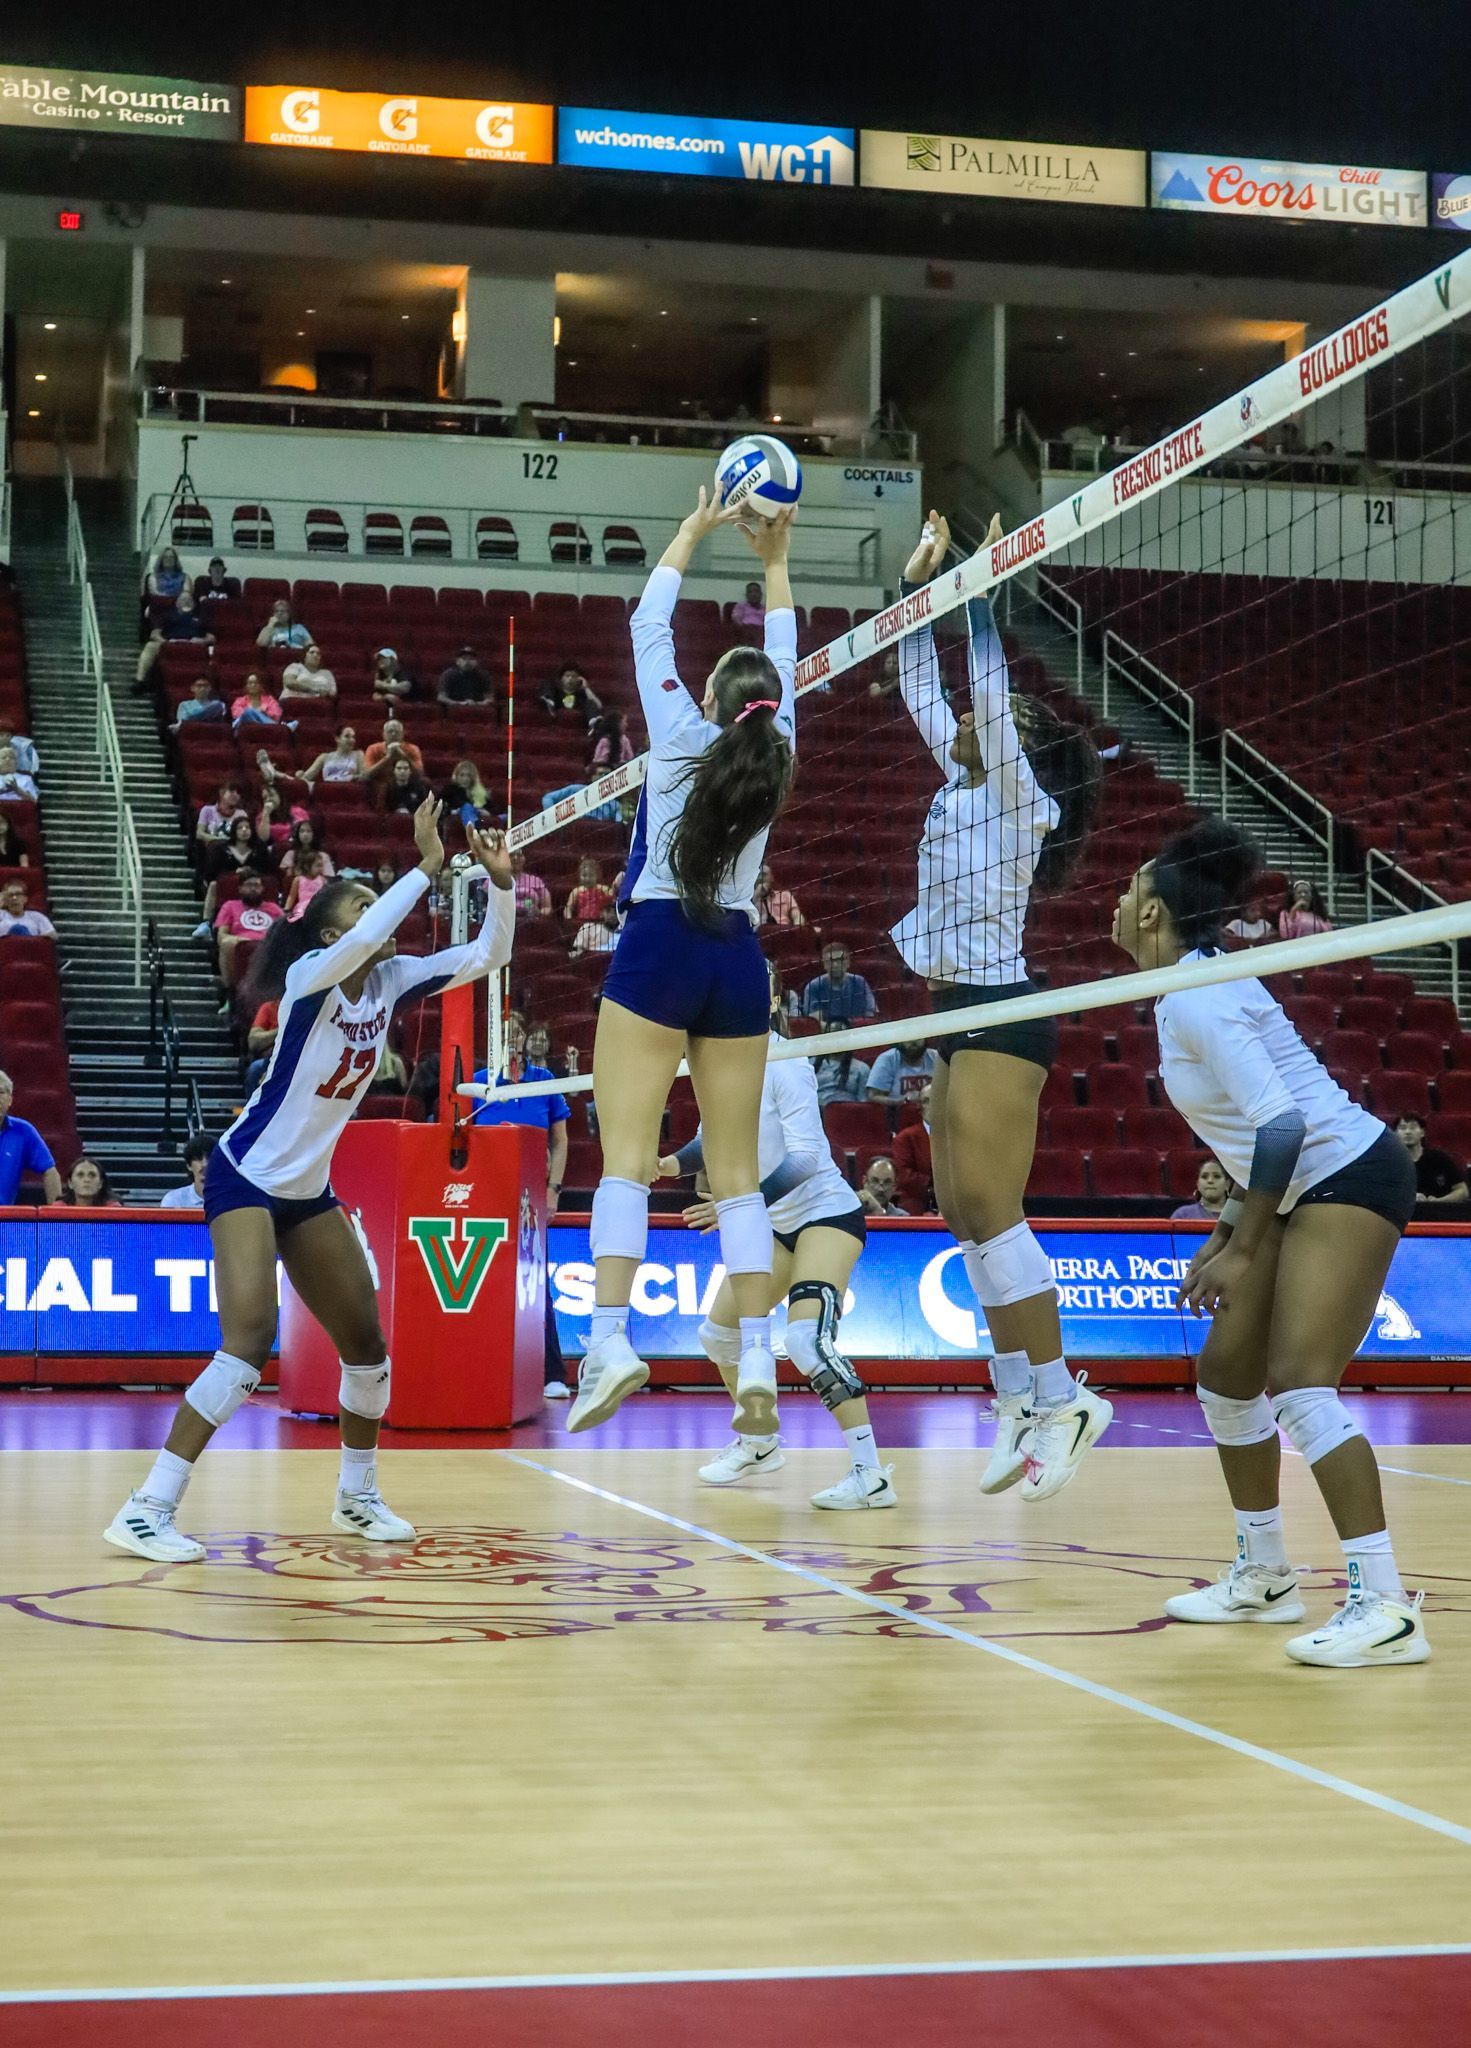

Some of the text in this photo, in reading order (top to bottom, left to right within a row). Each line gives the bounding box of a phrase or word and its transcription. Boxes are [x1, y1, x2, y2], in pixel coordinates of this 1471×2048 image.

[0, 78, 231, 114] able Mountain
[33, 102, 185, 126] Casino Resort
[270, 132, 333, 146] GATORADE
[368, 140, 431, 154] GATORADE
[575, 126, 725, 154] wchomes.com
[465, 147, 527, 162] GATORADE
[950, 143, 1100, 181] PALMILLA
[1338, 168, 1381, 185] Chill
[1207, 165, 1420, 218] Coors LIGHT
[1439, 198, 1468, 216] BLUE
[1299, 308, 1388, 397] BULLDOGS
[522, 452, 558, 480] 122
[844, 468, 914, 483] COCKTAILS
[1113, 422, 1205, 505] FRESNO STATE
[1364, 499, 1393, 525] 121
[991, 518, 1046, 577] BULLDOGS
[874, 587, 932, 644] FRESNO STATE
[408, 1216, 508, 1313] V
[1050, 1255, 1192, 1280] IERRA PACIF
[0, 1257, 137, 1311] IAL
